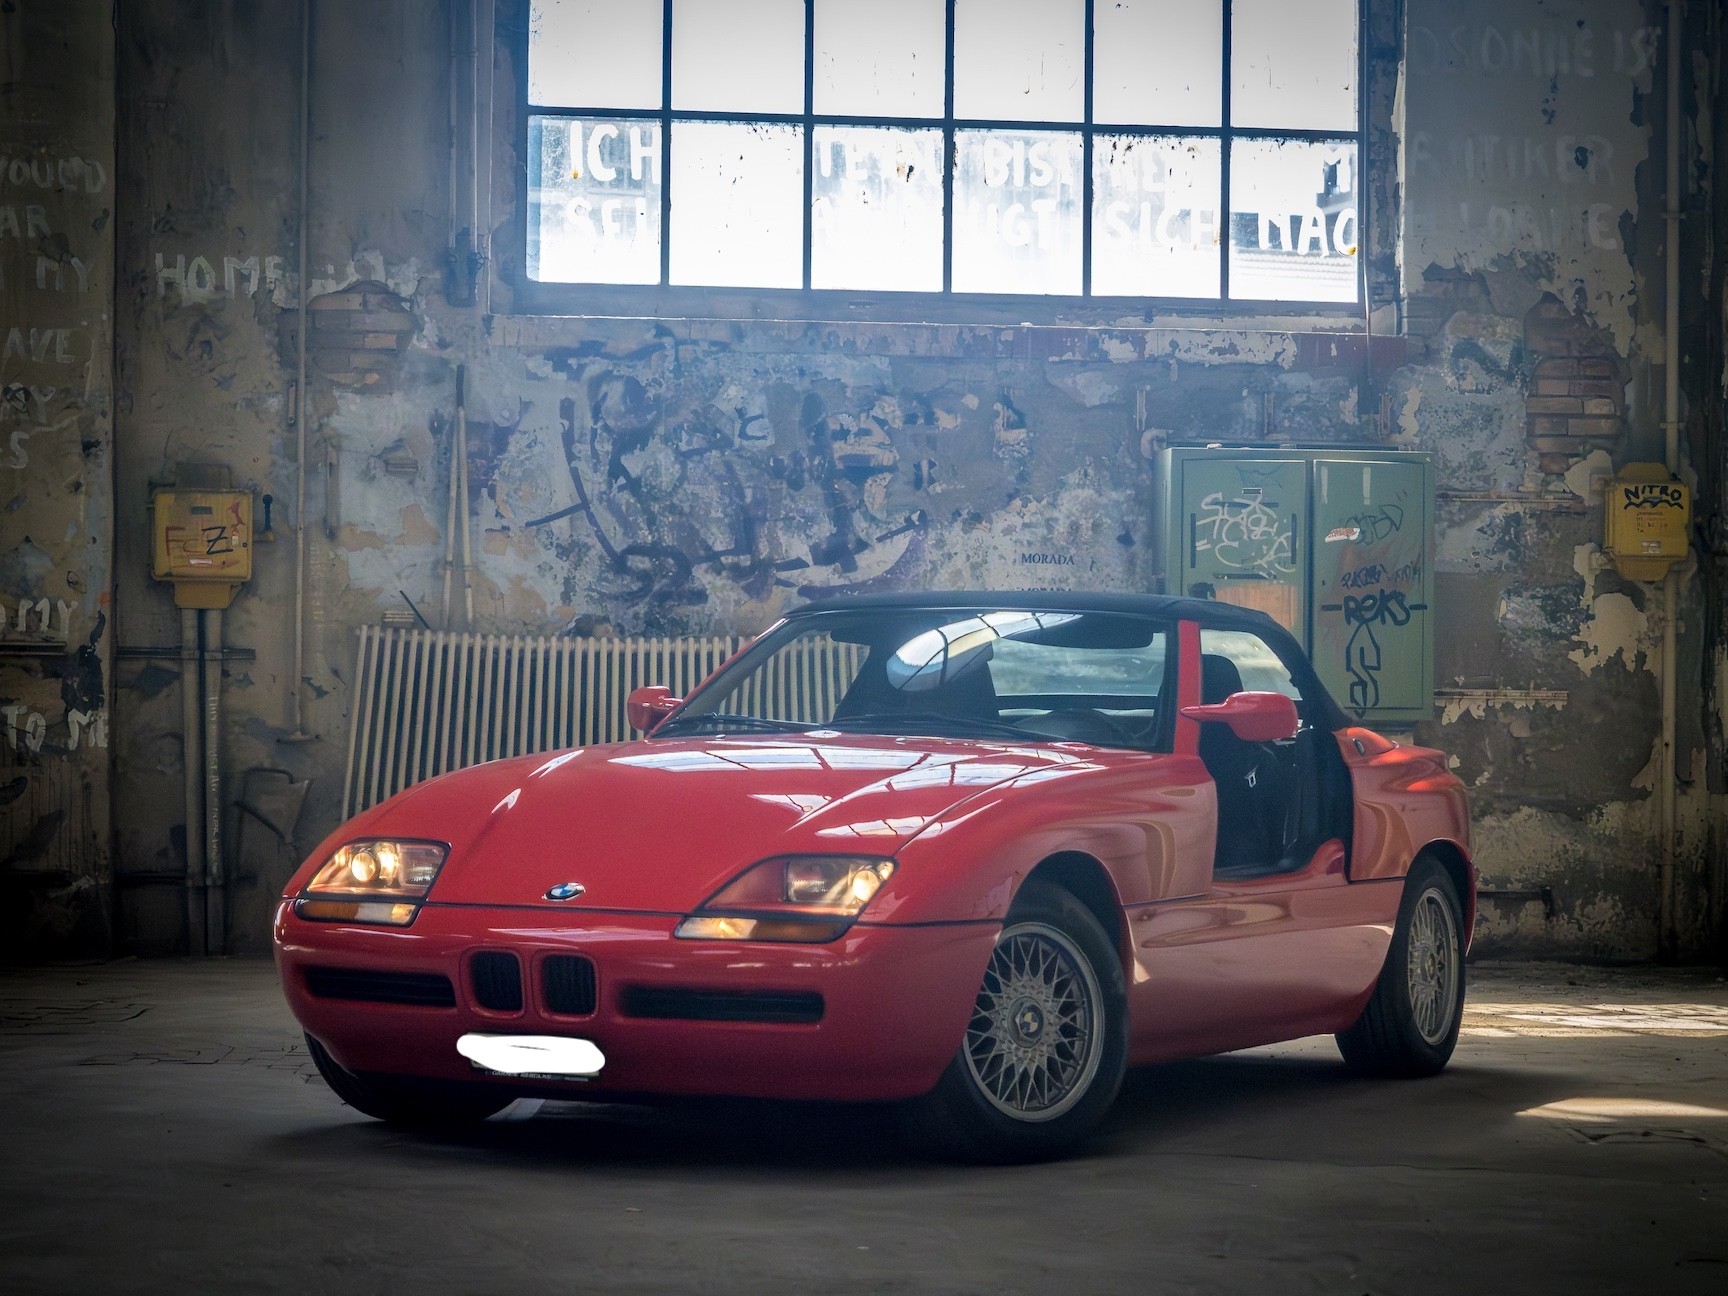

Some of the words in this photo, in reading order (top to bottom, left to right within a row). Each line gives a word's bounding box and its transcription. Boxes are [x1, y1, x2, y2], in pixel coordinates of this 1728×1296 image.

[570, 121, 661, 185] ICH
[1624, 485, 1682, 502] NITRO
[1021, 553, 1075, 566] MORADA
[1, 705, 47, 752] TO
